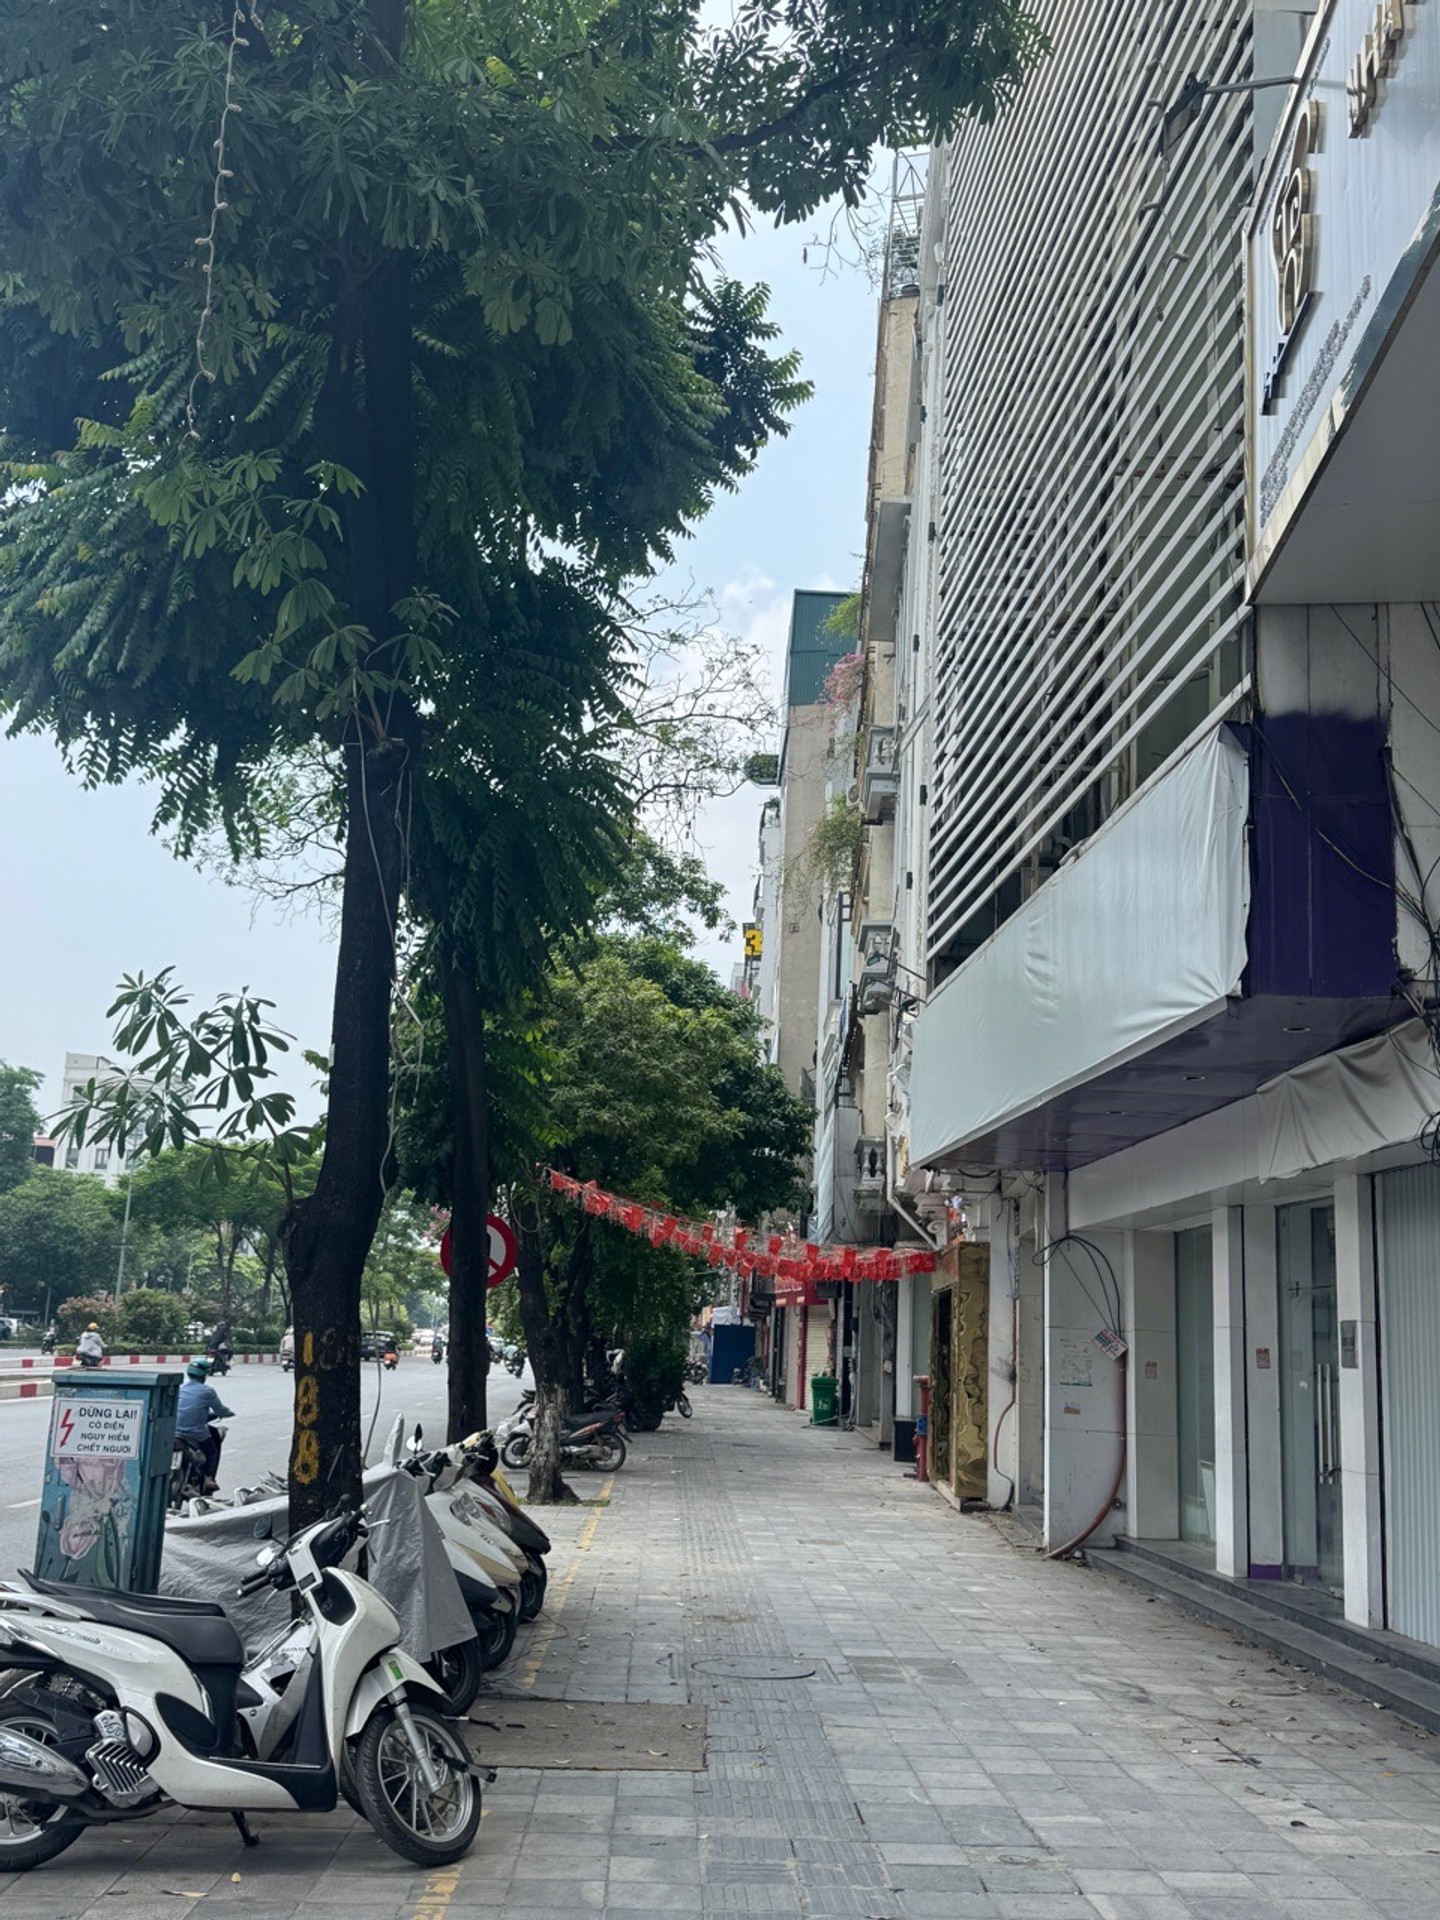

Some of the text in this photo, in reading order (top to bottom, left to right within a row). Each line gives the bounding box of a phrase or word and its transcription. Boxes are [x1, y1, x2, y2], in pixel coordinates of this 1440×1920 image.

[79, 1405, 112, 1419] DỪNG
[88, 1420, 102, 1429] CÓ
[80, 1432, 106, 1441] NGUY
[76, 1441, 101, 1452] CHẾT
